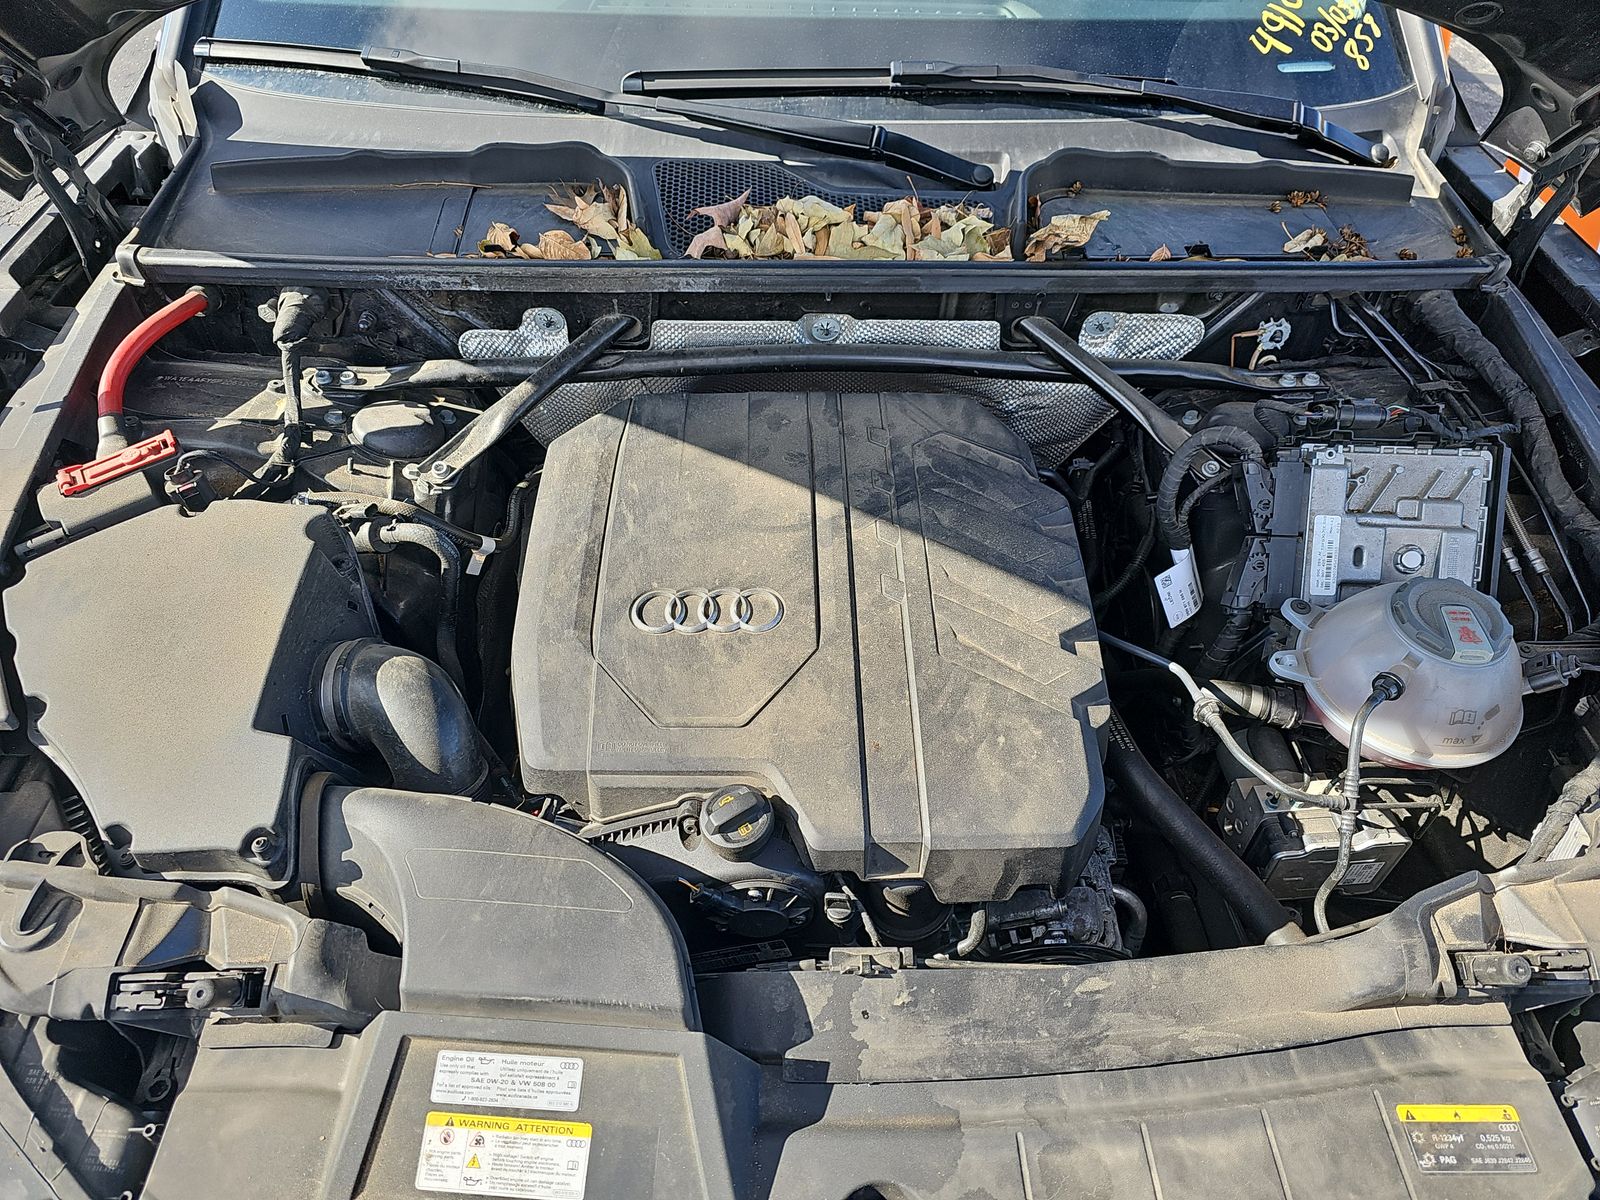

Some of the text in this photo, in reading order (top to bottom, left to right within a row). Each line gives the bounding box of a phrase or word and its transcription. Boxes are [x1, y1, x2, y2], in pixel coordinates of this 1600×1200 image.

[1442, 736, 1466, 745] max
[458, 1119, 574, 1134] WARNING ATTENTION
[1501, 1134, 1512, 1143] kg
[1439, 1155, 1457, 1164] PAG
